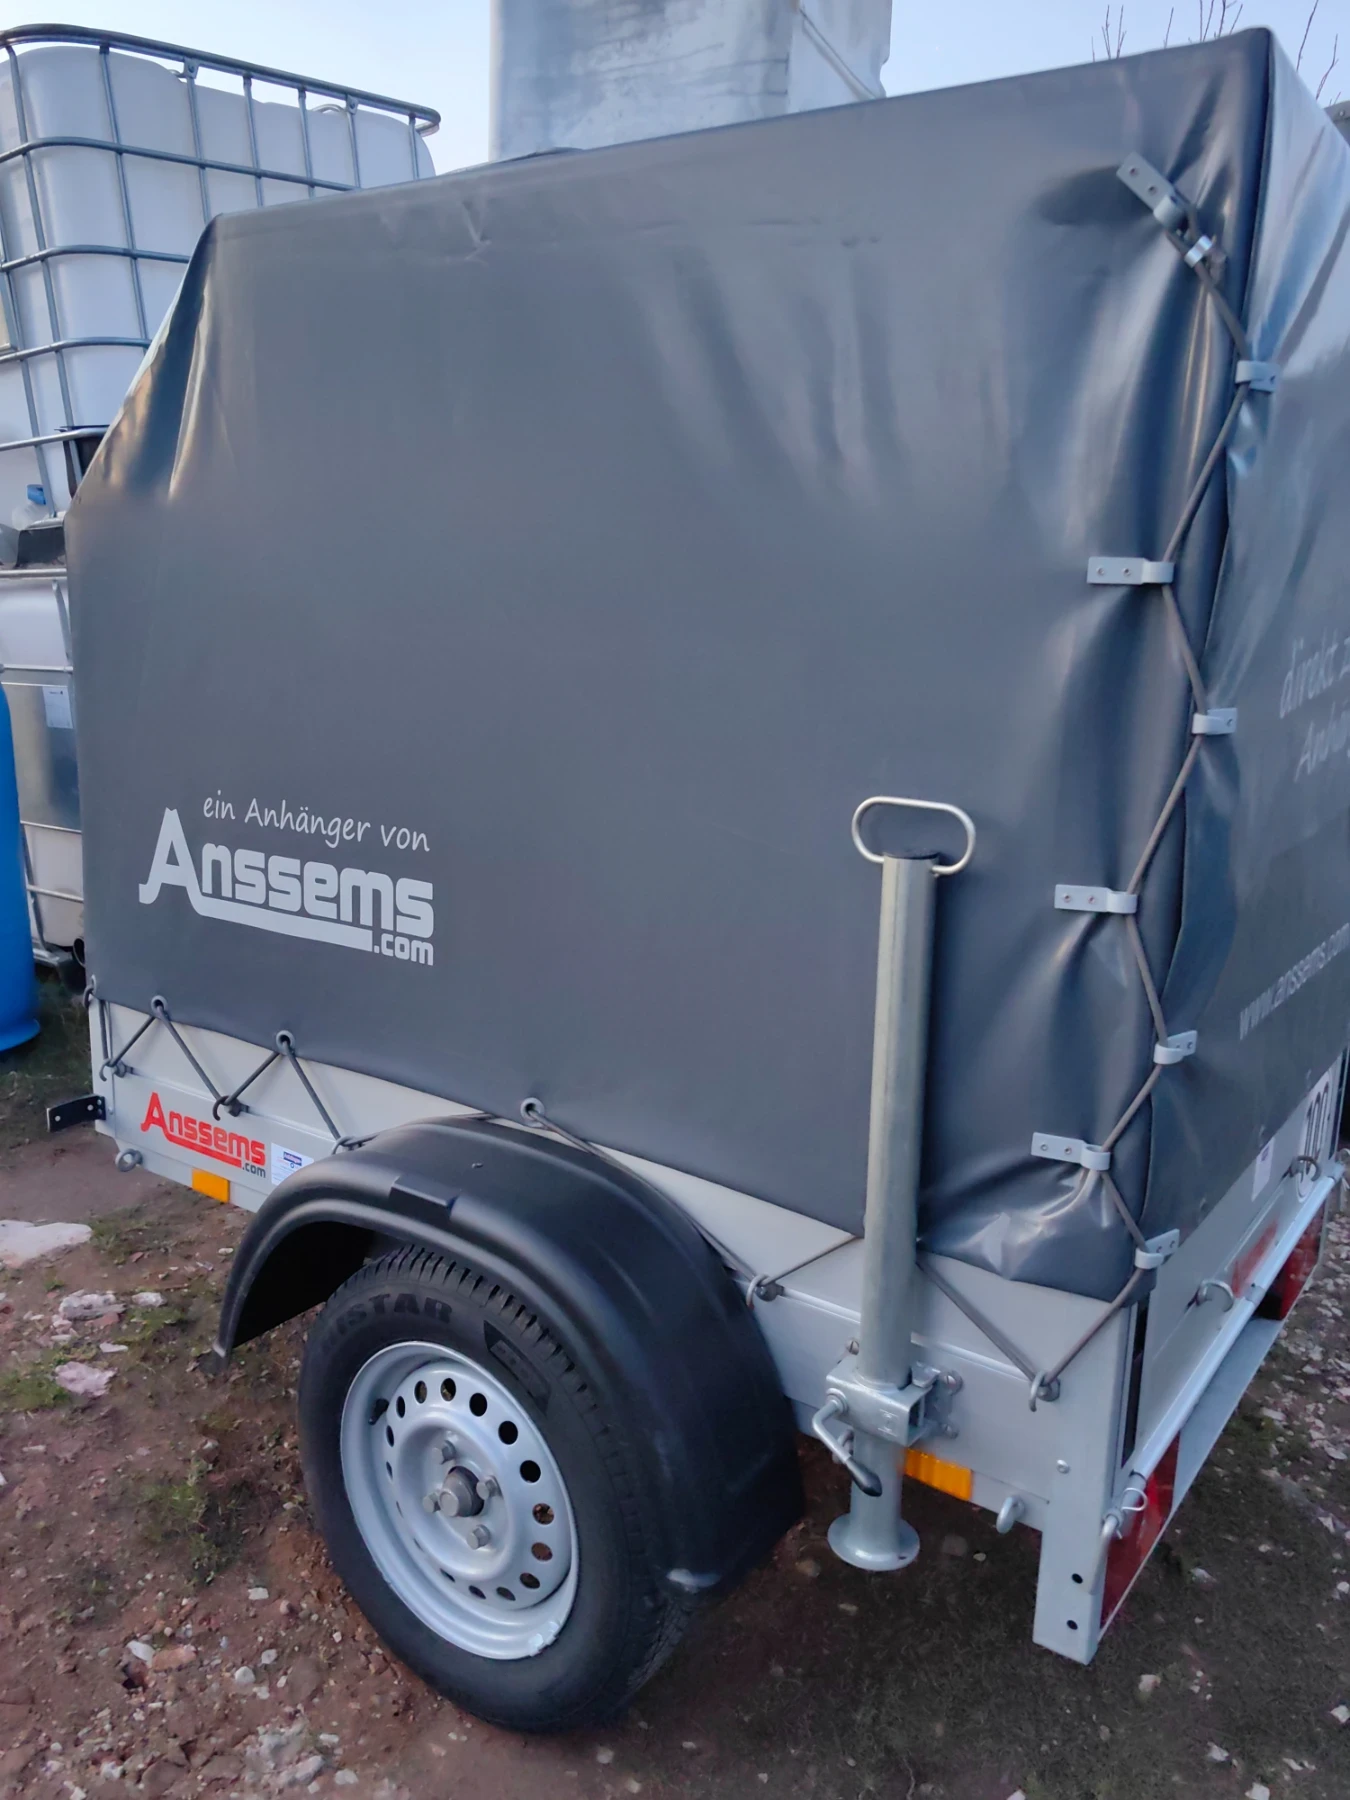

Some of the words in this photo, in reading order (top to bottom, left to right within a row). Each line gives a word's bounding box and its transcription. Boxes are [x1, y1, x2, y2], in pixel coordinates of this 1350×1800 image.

[203, 789, 236, 820] ein
[244, 798, 371, 848] Anhänger
[380, 825, 430, 851] von
[138, 806, 434, 939] Anssems
[140, 1091, 266, 1168] Anssems
